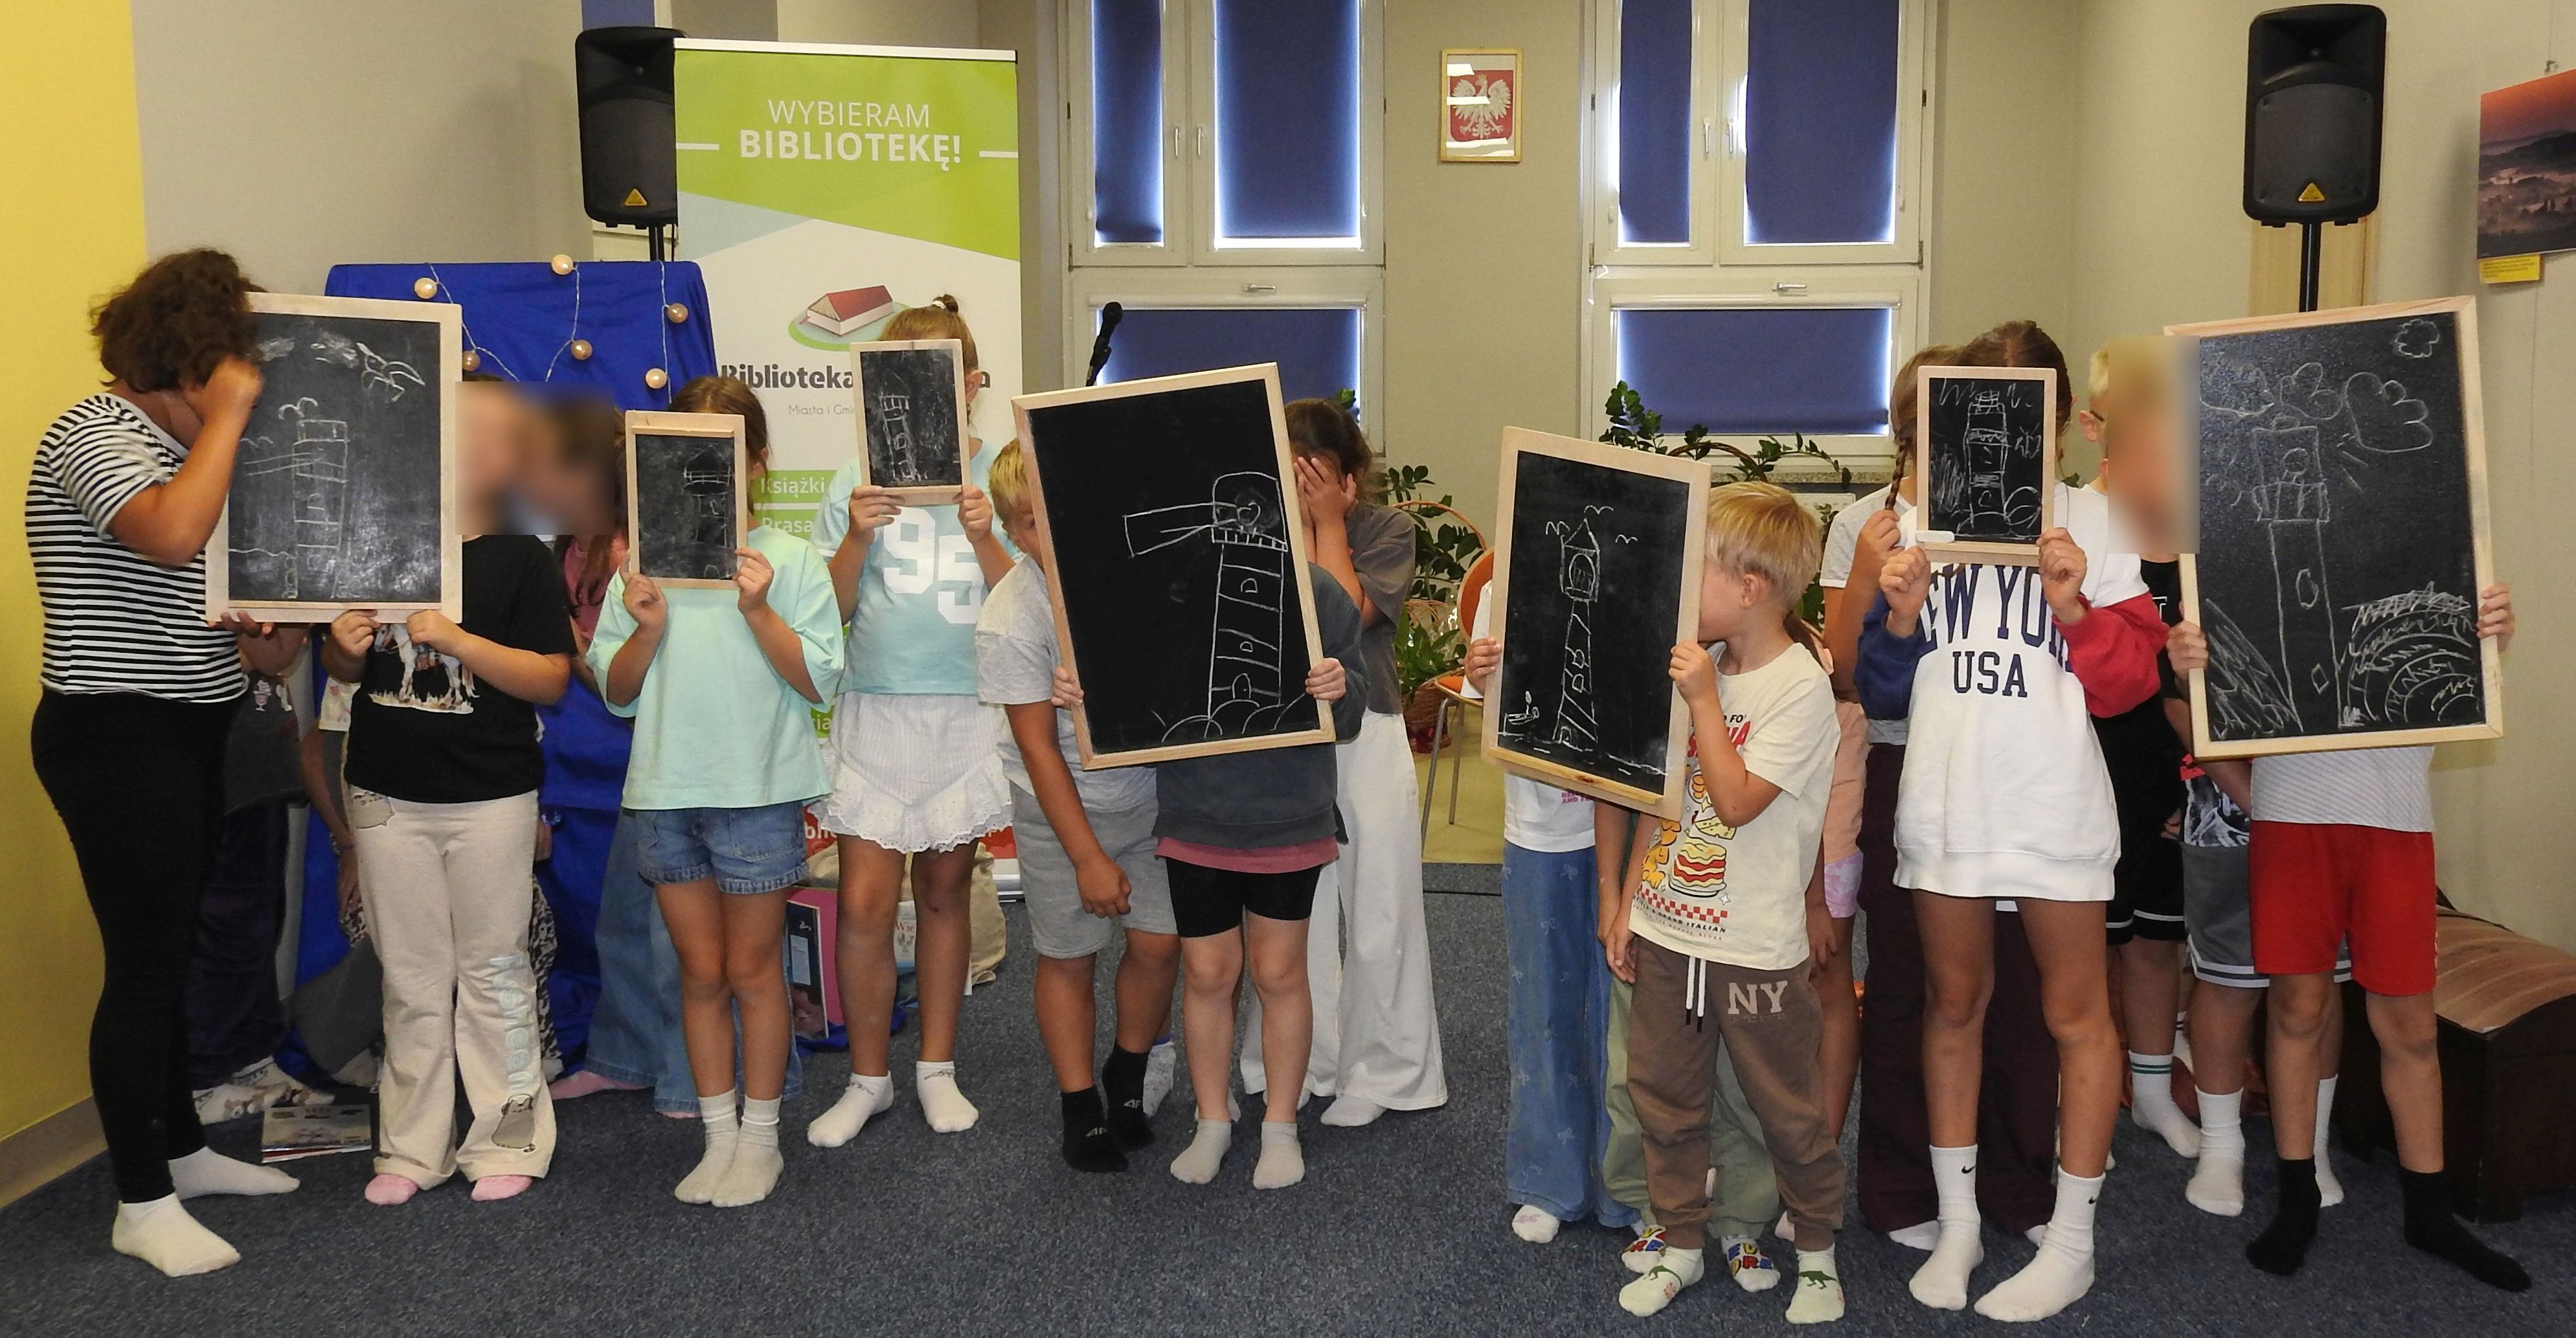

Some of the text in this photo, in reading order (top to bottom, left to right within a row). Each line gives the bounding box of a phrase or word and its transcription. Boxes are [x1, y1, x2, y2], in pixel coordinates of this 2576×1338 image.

[768, 99, 929, 128] WYBIERAM
[740, 129, 961, 171] BIBLIOTEKĘ!
[789, 405, 824, 415] Miasta
[761, 476, 825, 498] Książki
[883, 506, 984, 624] 95
[1921, 563, 1983, 650] EW
[1952, 651, 2028, 698] USA
[1686, 922, 1726, 933] ITALIAN
[1727, 980, 1789, 1015] NY
